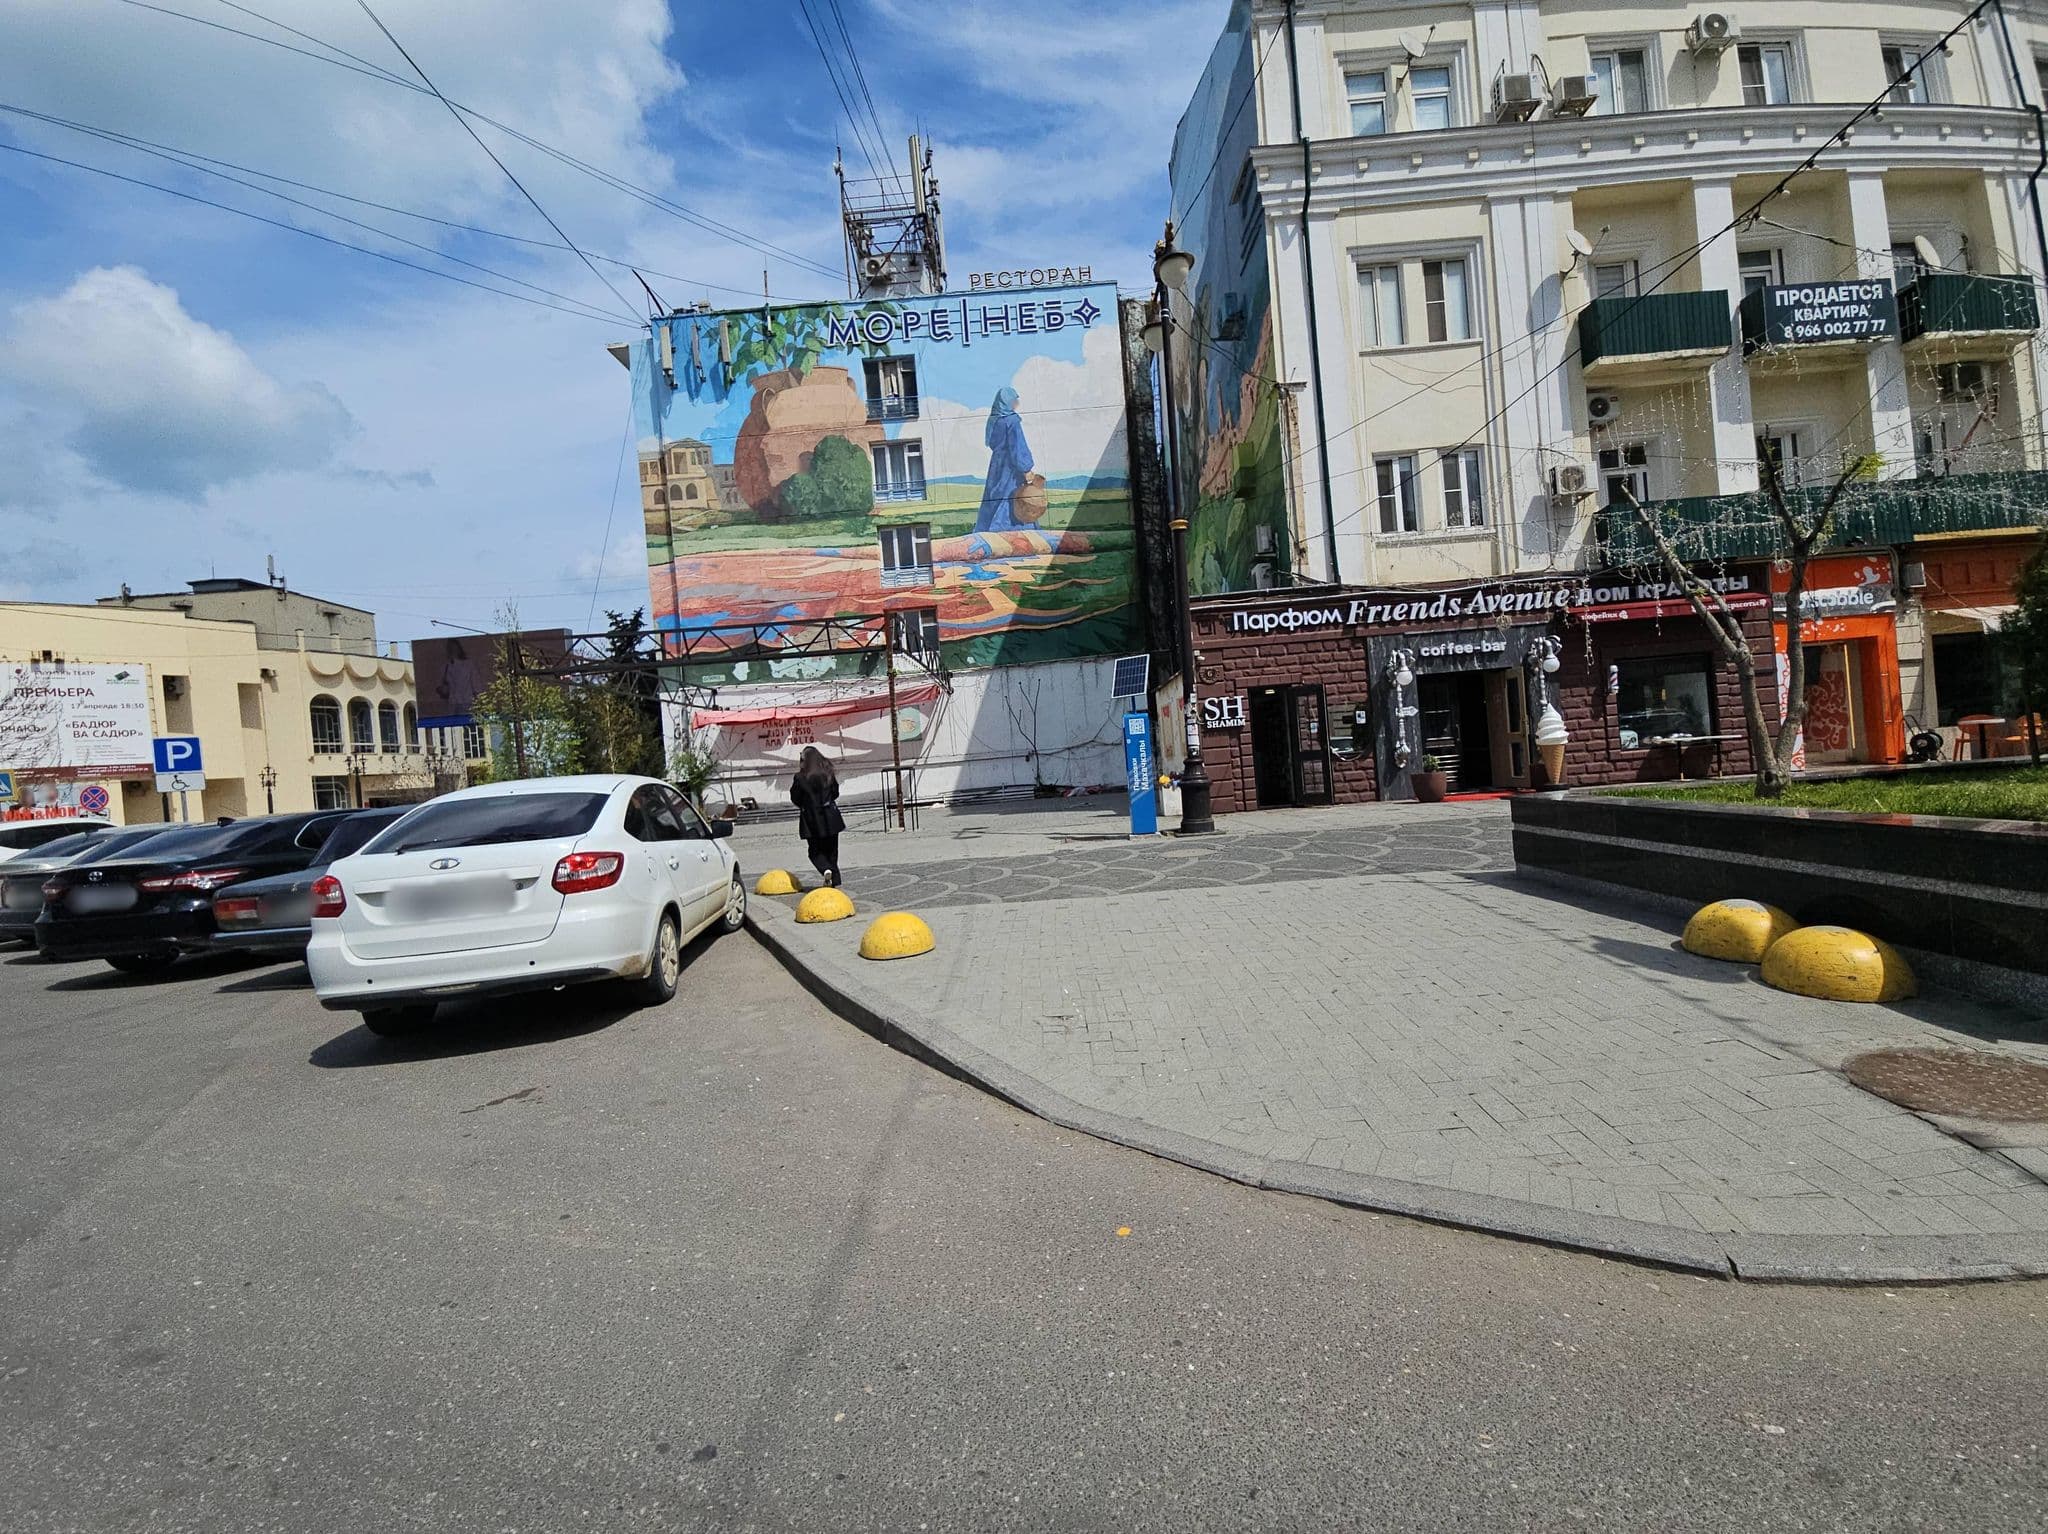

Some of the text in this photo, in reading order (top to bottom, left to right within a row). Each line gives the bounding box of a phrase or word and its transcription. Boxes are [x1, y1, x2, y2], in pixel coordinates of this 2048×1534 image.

[969, 265, 1092, 290] РЕСТОРАН
[1775, 284, 1883, 306] ПРОДАЕТСЯ
[1794, 304, 1869, 321] КВАРТИРА
[1784, 319, 1886, 338] 8 966 002 77 77
[1346, 588, 1570, 625] Friends Avenue
[1575, 586, 1630, 606] ДОМ
[1233, 608, 1342, 632] Парфюм
[1420, 640, 1507, 657] coffee-bar
[13, 687, 95, 698] ПРЕМЬЕРА
[1204, 695, 1246, 721] SH
[1207, 719, 1246, 729] SHAMIM
[166, 741, 193, 769] P
